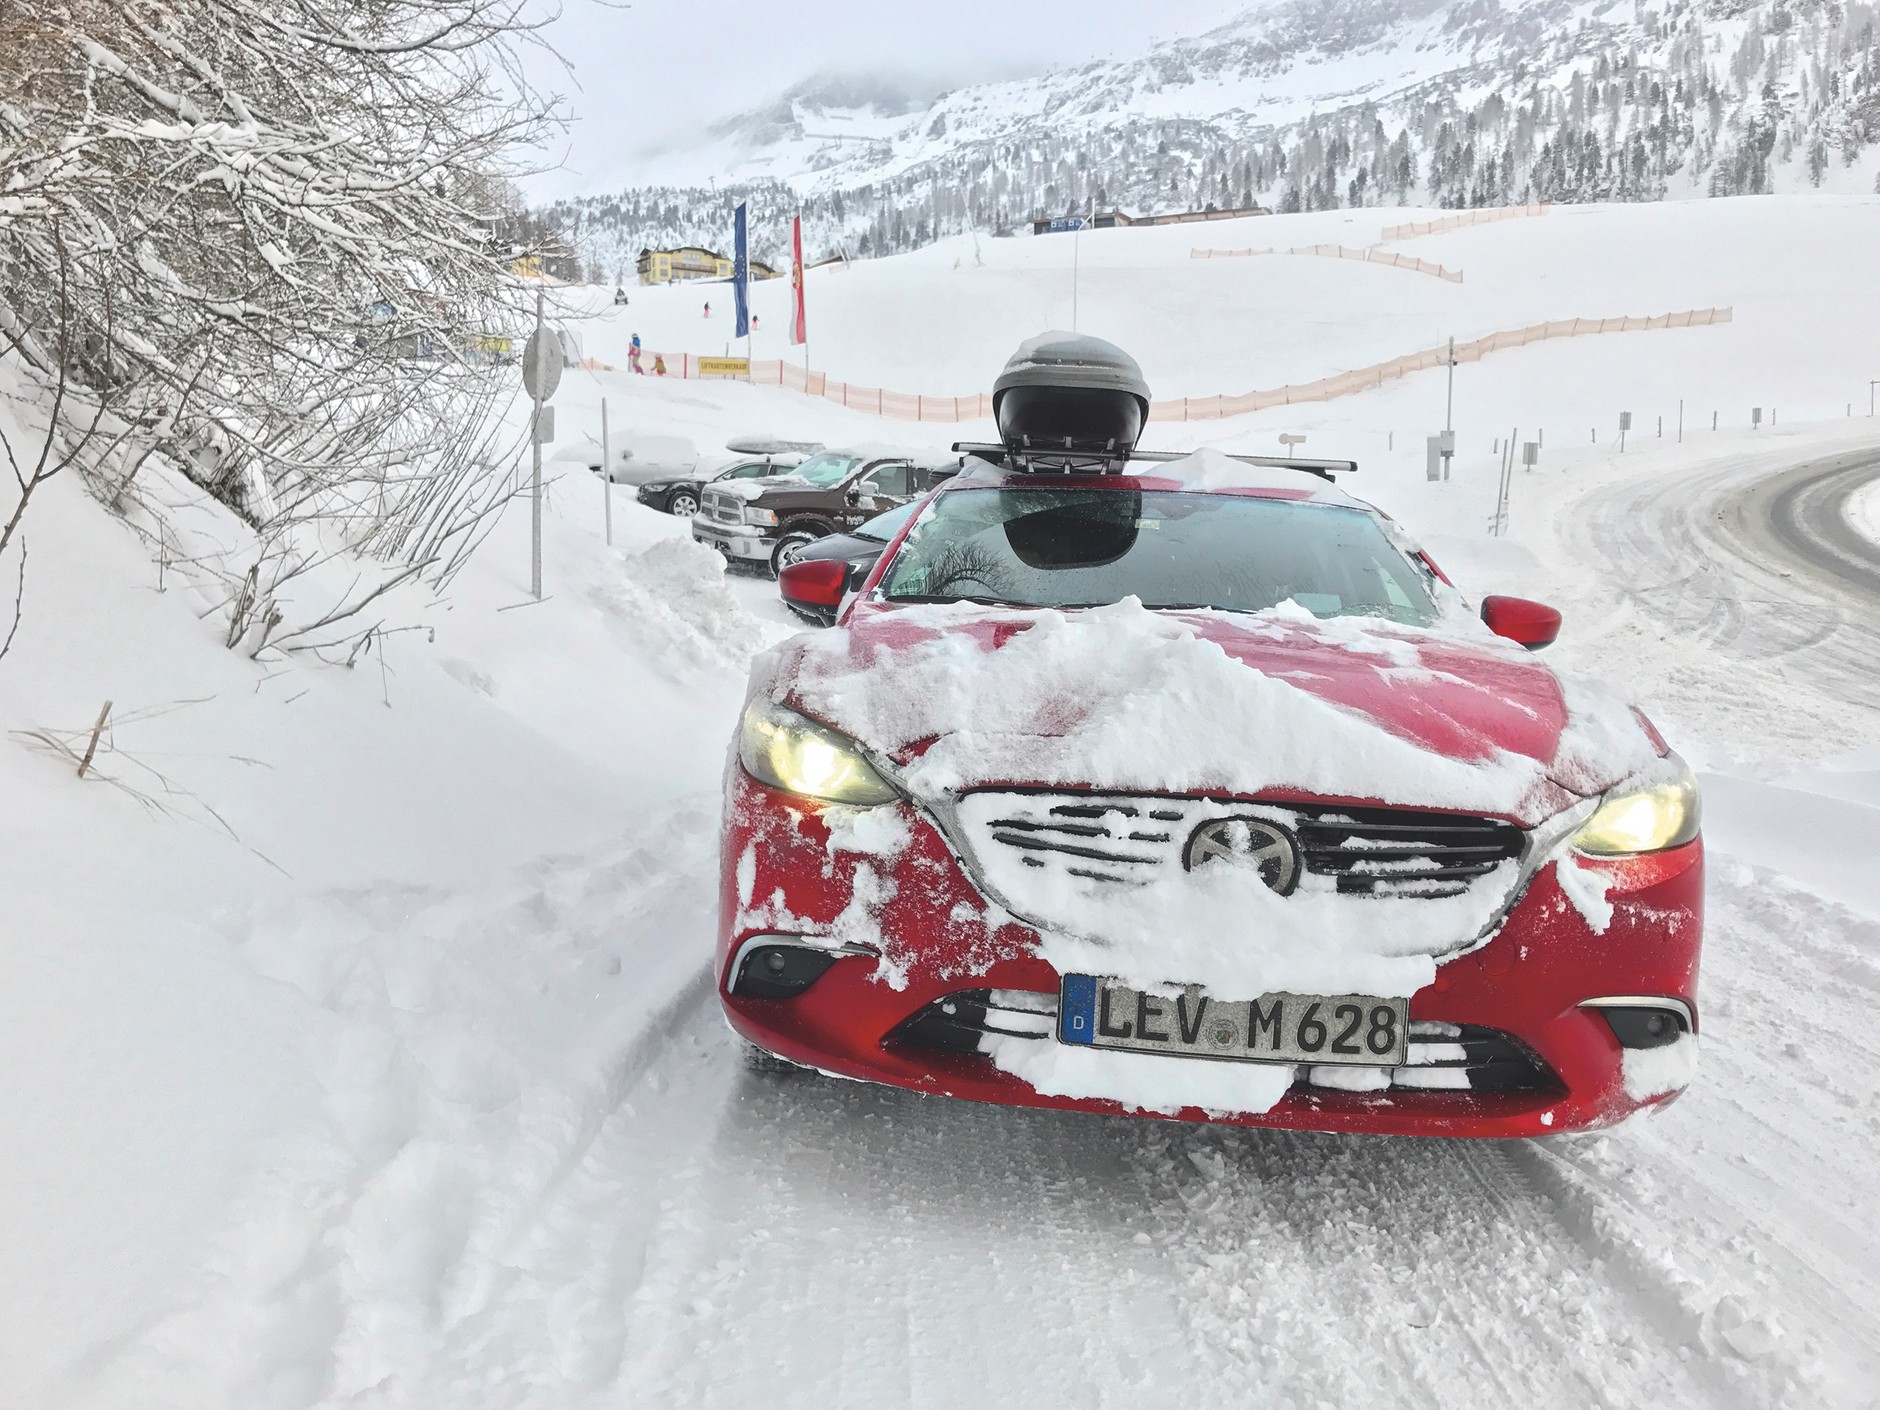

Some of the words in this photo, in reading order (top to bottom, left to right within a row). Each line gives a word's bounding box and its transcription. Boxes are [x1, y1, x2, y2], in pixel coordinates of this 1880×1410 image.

[1073, 1015, 1084, 1030] D
[1098, 986, 1208, 1044] LEV
[1247, 998, 1283, 1050] M
[1296, 1002, 1397, 1055] 628
